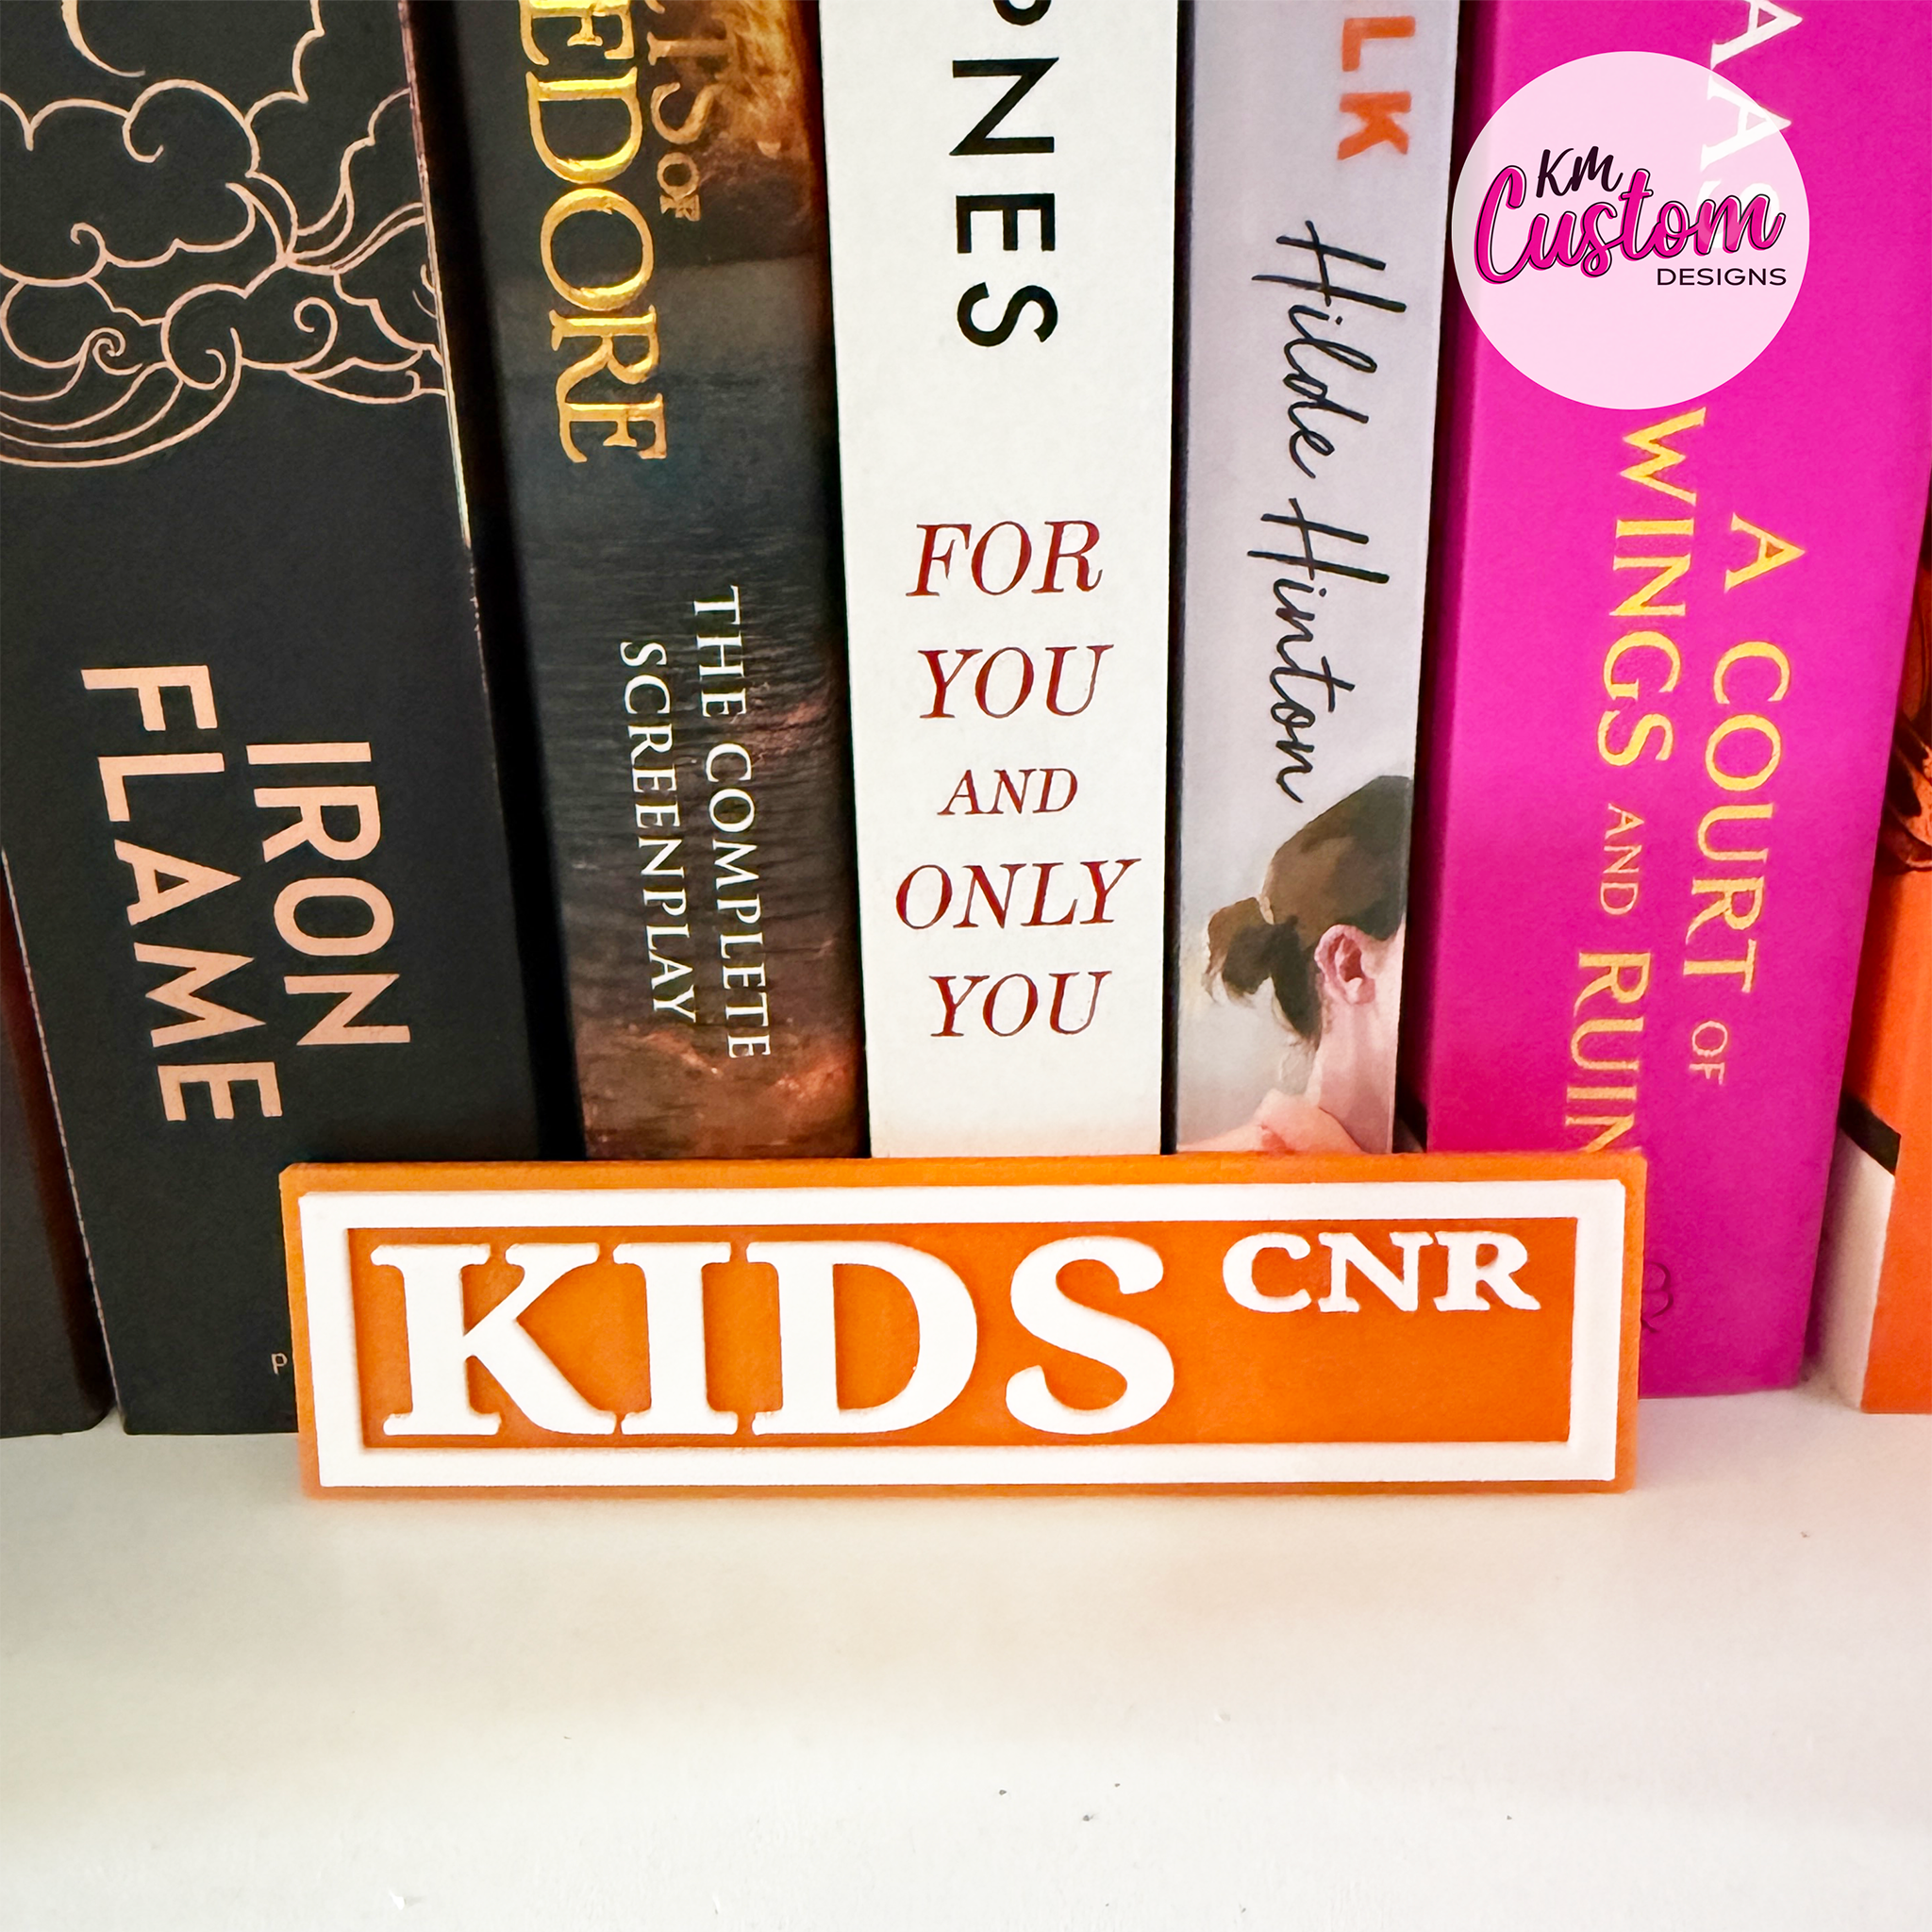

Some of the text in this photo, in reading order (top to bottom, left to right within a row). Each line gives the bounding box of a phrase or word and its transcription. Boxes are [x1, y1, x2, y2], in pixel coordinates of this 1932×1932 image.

[645, 0, 735, 144] TS
[1337, 15, 1416, 160] LK
[520, 0, 668, 463] EDORE
[906, 521, 1103, 597] FOR
[1246, 220, 1407, 803] Hilde Hinton
[1598, 407, 1707, 767] WINGS
[917, 644, 1113, 719] YOU
[80, 664, 283, 1122] FLAME
[246, 741, 411, 1046] IRON
[620, 641, 697, 1024] SCREENPLAY
[692, 585, 772, 1058] THE COMPLETE
[895, 858, 1141, 929] ONLY
[937, 768, 1078, 816] AND
[1600, 803, 1645, 915] AND
[1683, 512, 1806, 1085] A COURT OF
[929, 971, 1112, 1038] YOU
[370, 1231, 1541, 1436] KIDS CNR
